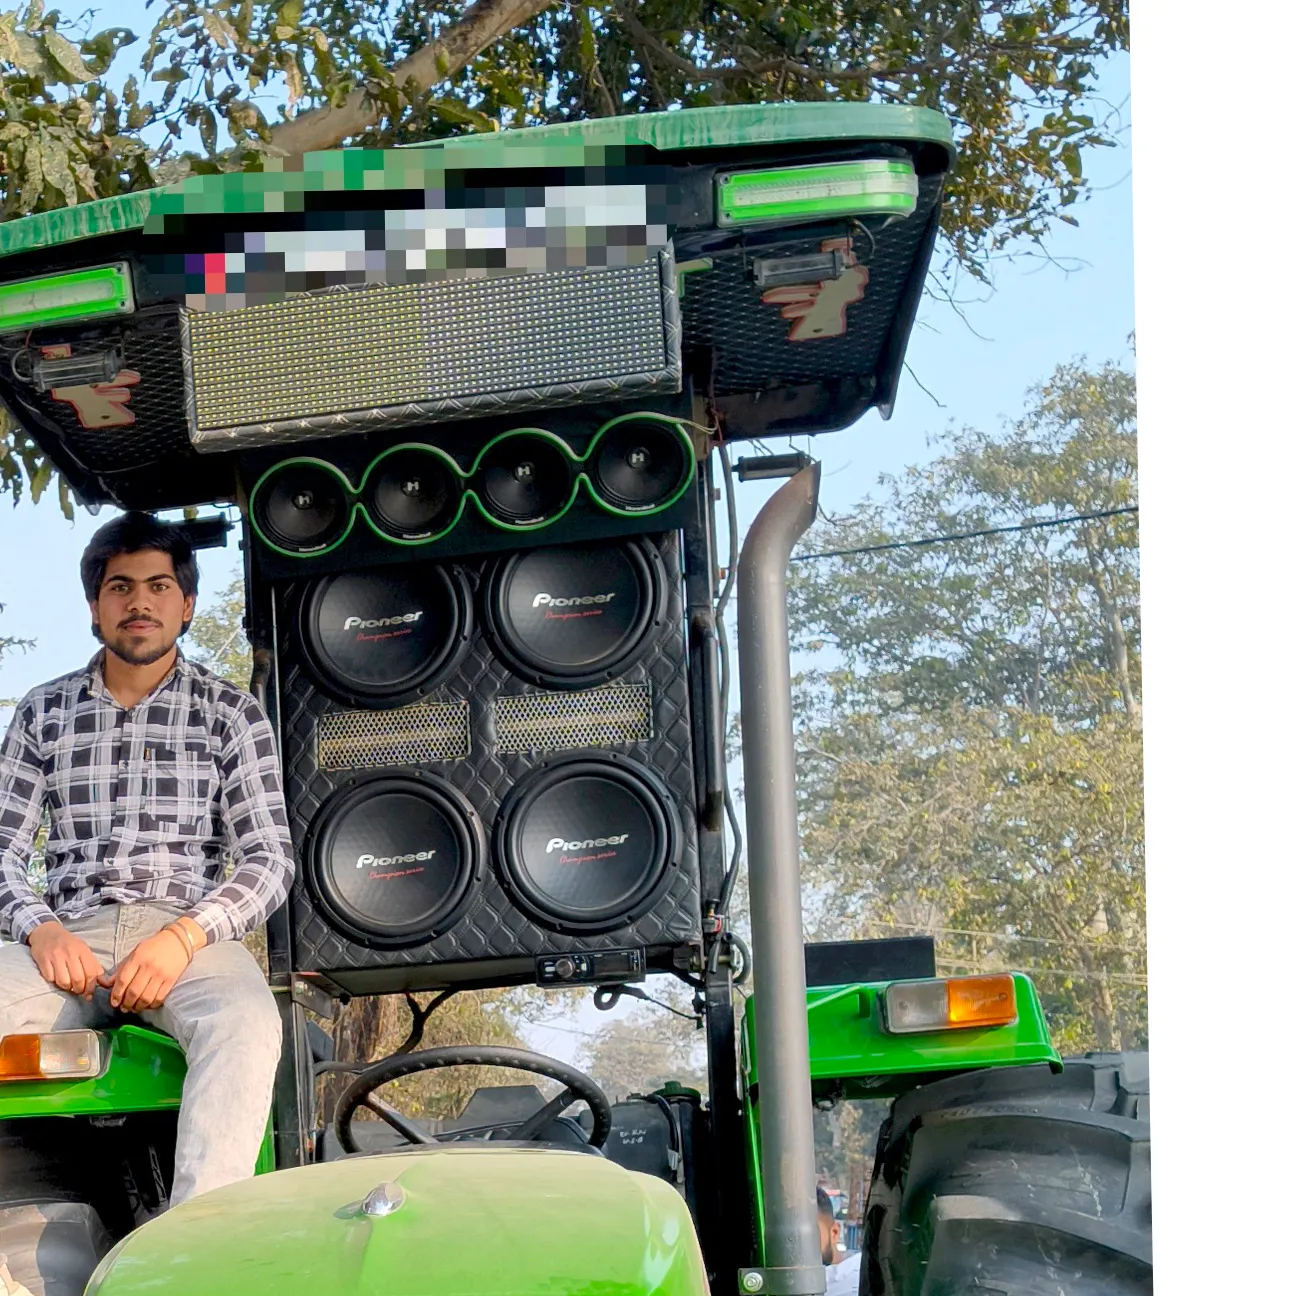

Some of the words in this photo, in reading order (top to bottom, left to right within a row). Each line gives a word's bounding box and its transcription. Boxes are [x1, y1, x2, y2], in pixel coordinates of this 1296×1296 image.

[532, 592, 616, 608] Pioneer
[344, 611, 423, 630] Pioneer
[546, 834, 629, 853] Pioneer
[356, 850, 436, 868] Pioneer
